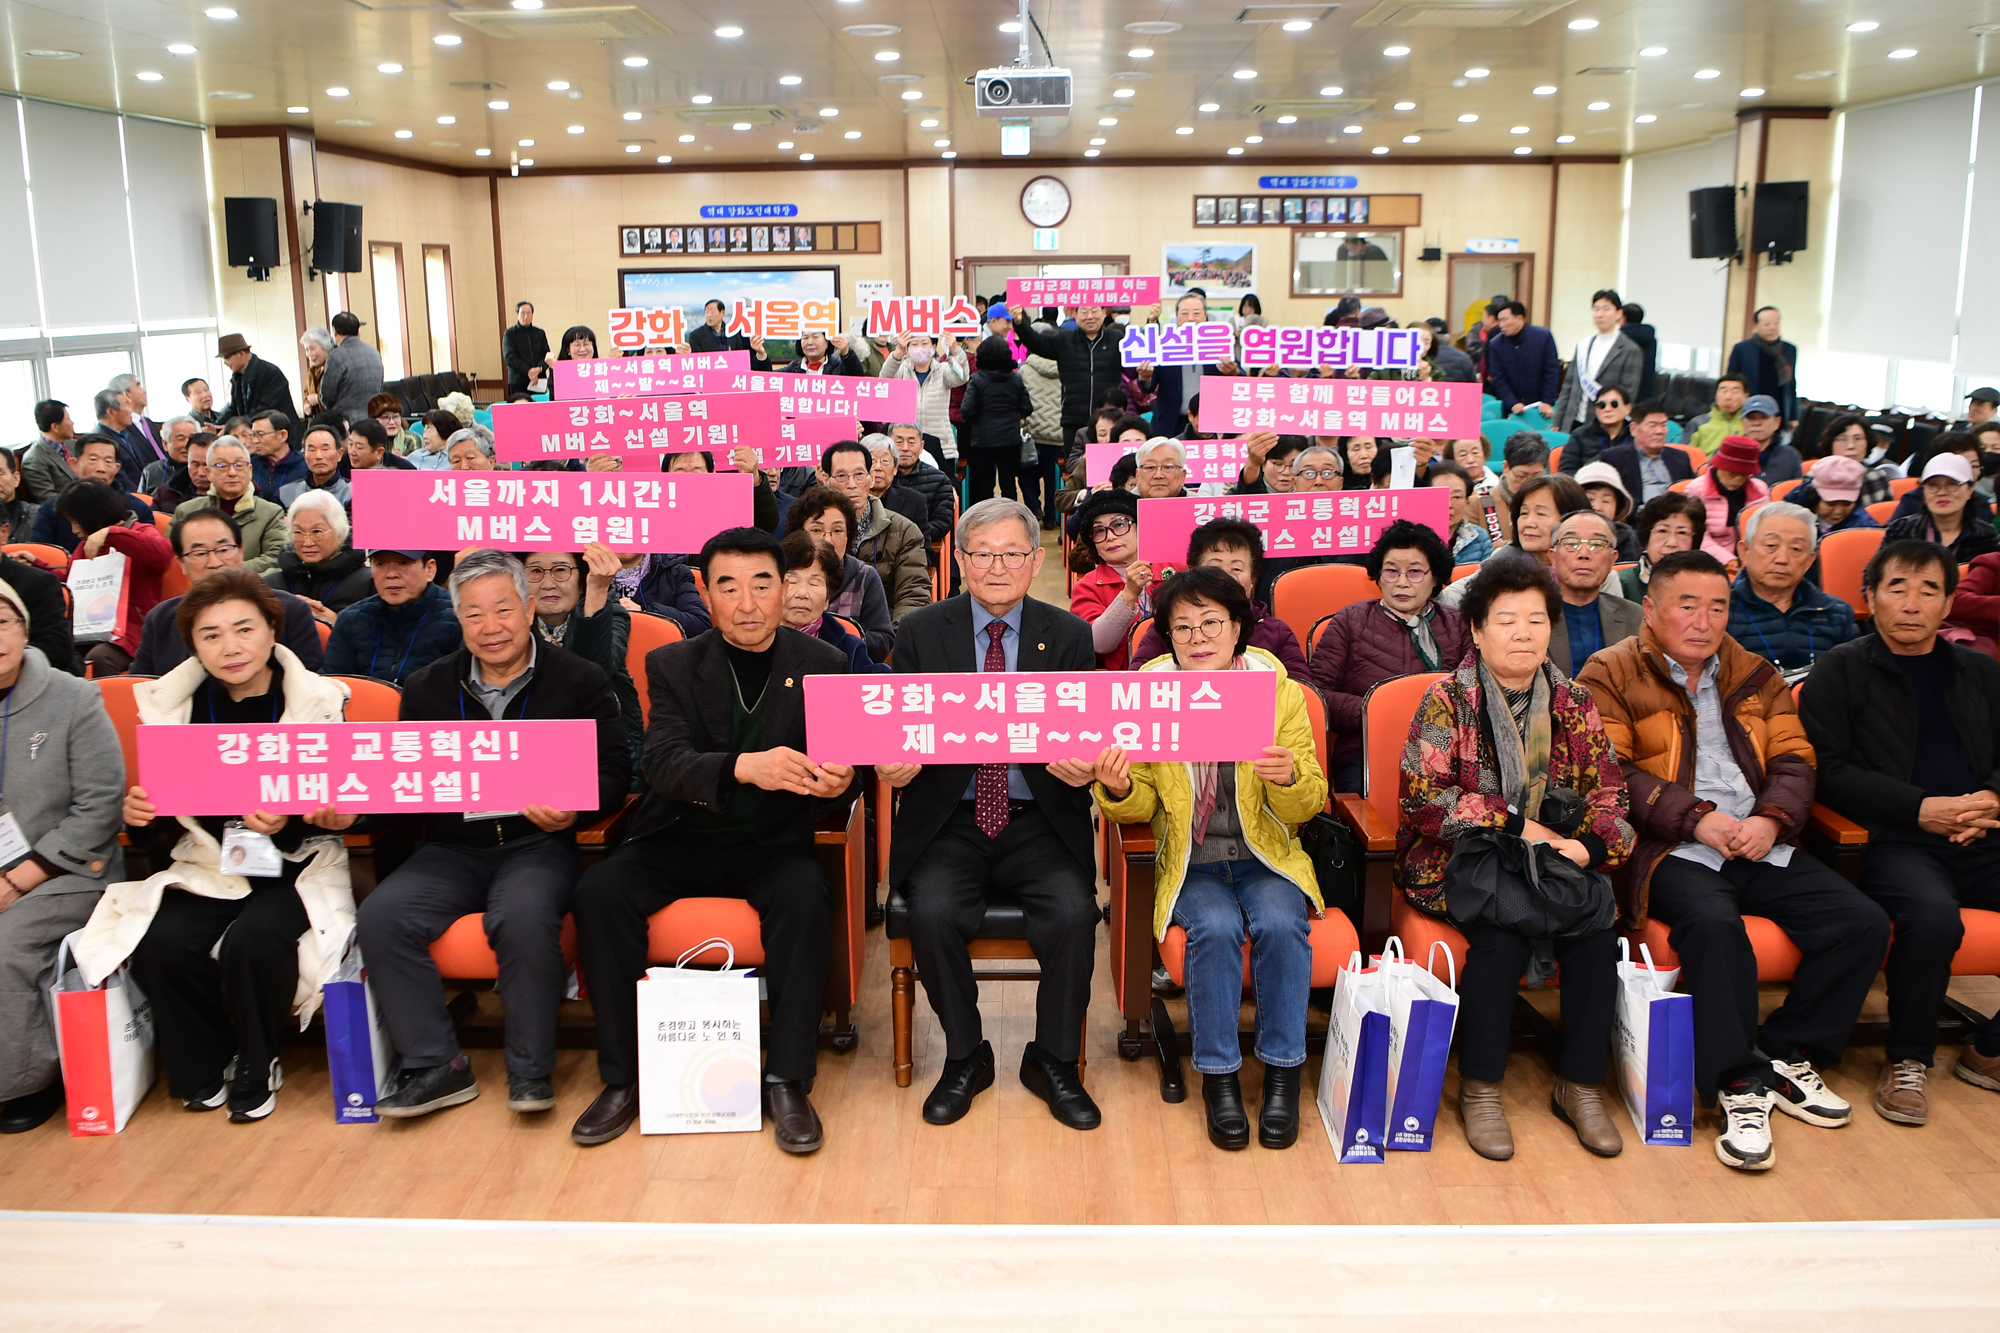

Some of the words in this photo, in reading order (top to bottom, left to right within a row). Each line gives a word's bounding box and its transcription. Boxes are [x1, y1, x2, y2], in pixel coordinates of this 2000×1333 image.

[1021, 280, 1070, 291] 강화군의
[1078, 280, 1114, 290] 미래를
[1123, 280, 1146, 289] 여는
[1031, 294, 1086, 304] 교통혁신!
[1094, 293, 1136, 302] M버스!
[609, 309, 687, 348] 강화
[727, 298, 838, 337] 서울역
[868, 296, 981, 338] M버스
[1122, 323, 1233, 365] 신설을
[1242, 327, 1422, 368] 염원합니다
[577, 358, 671, 377] 강화~서울역
[682, 356, 728, 370] M버스
[732, 375, 783, 394] 서울역
[794, 378, 844, 394] M버스
[856, 382, 888, 398] 신설
[1231, 383, 1275, 402] 모두
[1289, 384, 1333, 404] 함께
[1347, 386, 1450, 407] 만들어요!
[568, 400, 707, 426] 강화~서울역
[780, 397, 858, 416] 원합니다!
[1232, 408, 1366, 430] 강화~서울역
[1381, 412, 1448, 432] M버스
[542, 432, 610, 452] M버스
[624, 428, 668, 448] 신설
[684, 425, 738, 445] 기원!
[776, 445, 821, 462] 기원!
[429, 479, 558, 506] 서울까지
[579, 481, 676, 508] 1시간!
[1194, 501, 1269, 525] 강화군
[1286, 496, 1397, 520] 교통혁신!
[458, 516, 551, 542] M버스
[572, 516, 648, 544] 염원!
[1311, 526, 1370, 548] 신설!
[1484, 512, 1503, 542] UCCI
[861, 682, 1086, 714] 강화~서울역
[1112, 681, 1221, 711] M버스
[218, 733, 328, 764] 강화군
[352, 730, 518, 762] 교통혁신!
[902, 722, 1179, 754] 제~~발~~요!!
[261, 773, 368, 803] M버스
[391, 772, 480, 802] 신설!
